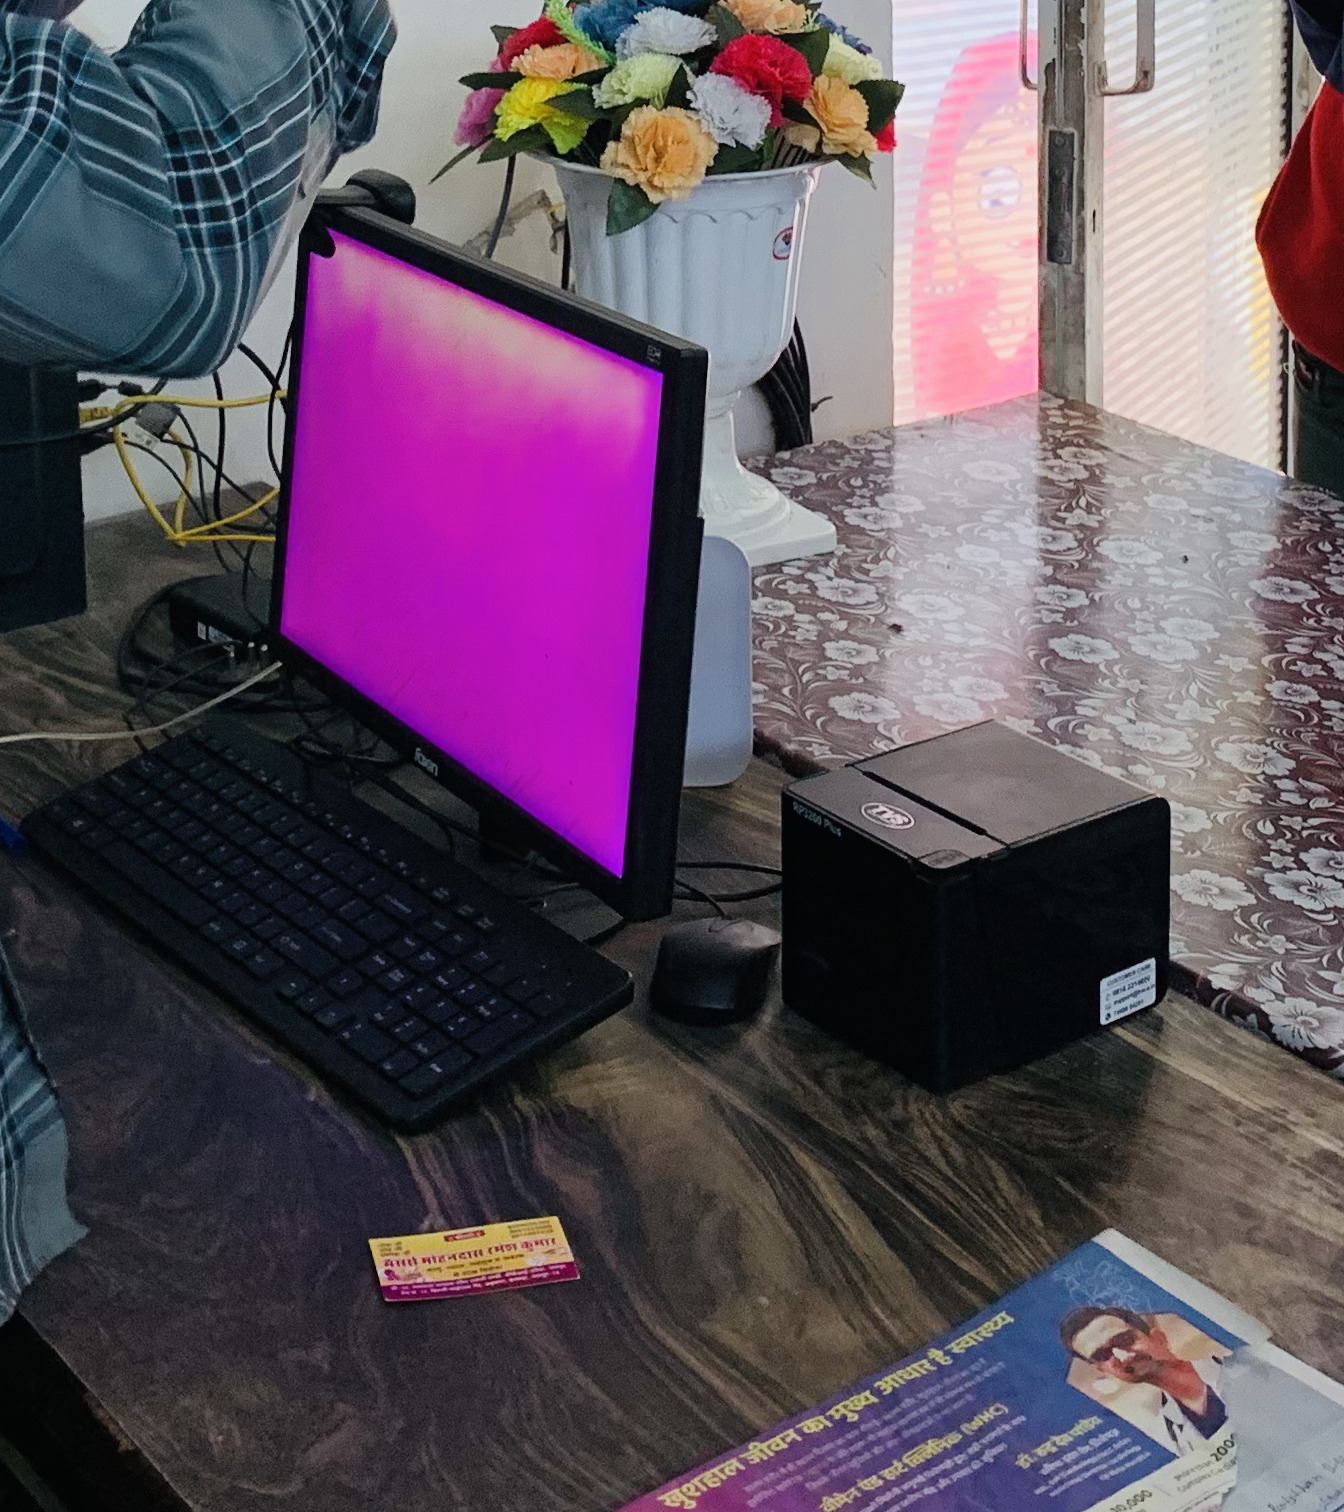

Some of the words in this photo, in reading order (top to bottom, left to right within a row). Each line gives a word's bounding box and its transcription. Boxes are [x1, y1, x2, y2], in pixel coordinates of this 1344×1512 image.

[657, 1458, 745, 1509] खुशहाल
[740, 1428, 802, 1465] जीवन
[795, 1415, 834, 1434] का
[825, 1390, 879, 1423] मुख्य
[874, 1359, 937, 1395] आधार
[927, 1347, 953, 1366] है
